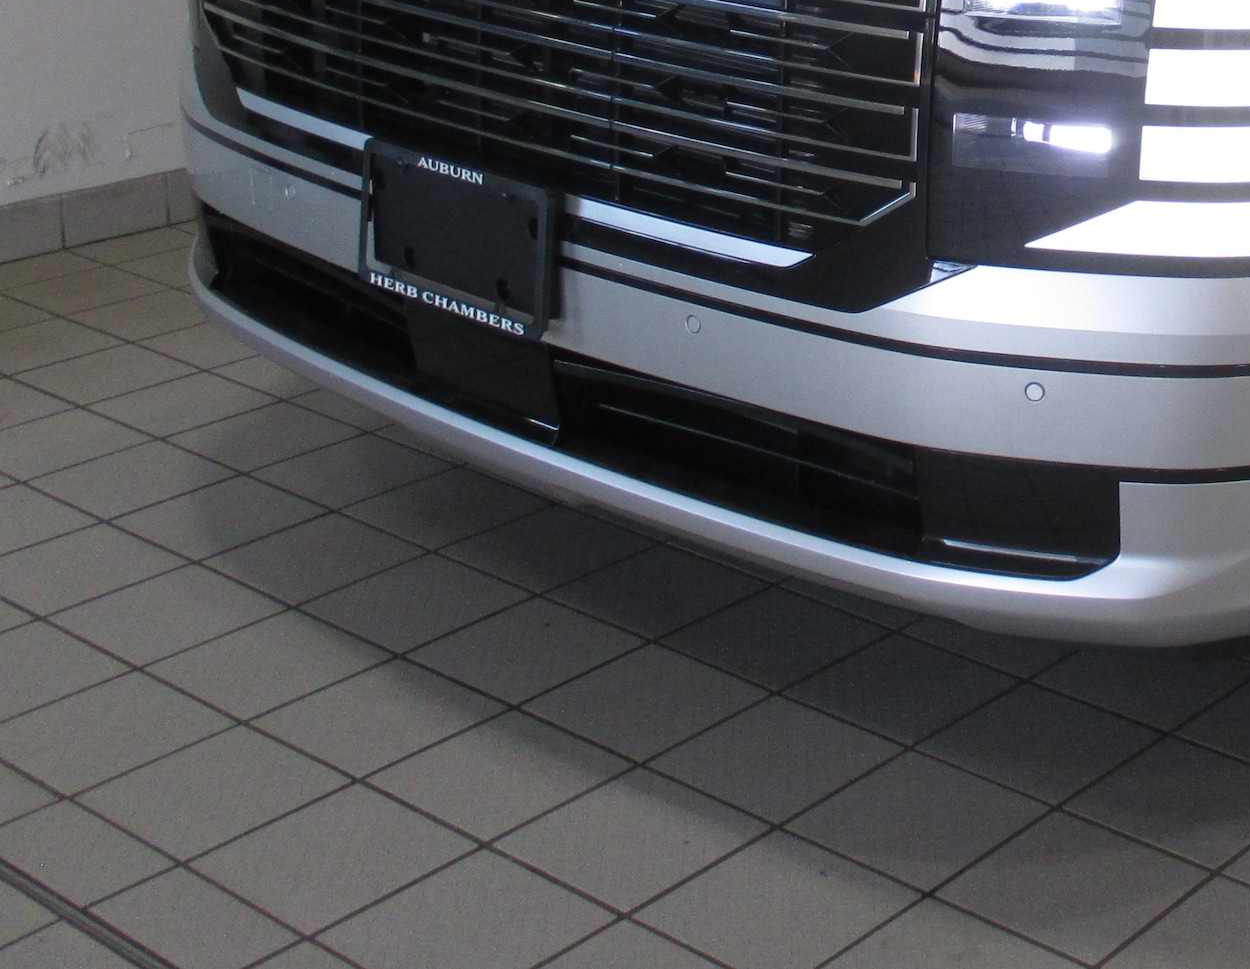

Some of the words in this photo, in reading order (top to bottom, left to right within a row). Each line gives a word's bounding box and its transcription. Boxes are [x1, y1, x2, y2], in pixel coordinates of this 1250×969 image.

[417, 157, 484, 185] AUBURN
[370, 273, 418, 299] HERB
[422, 291, 525, 336] CHAMBERS
